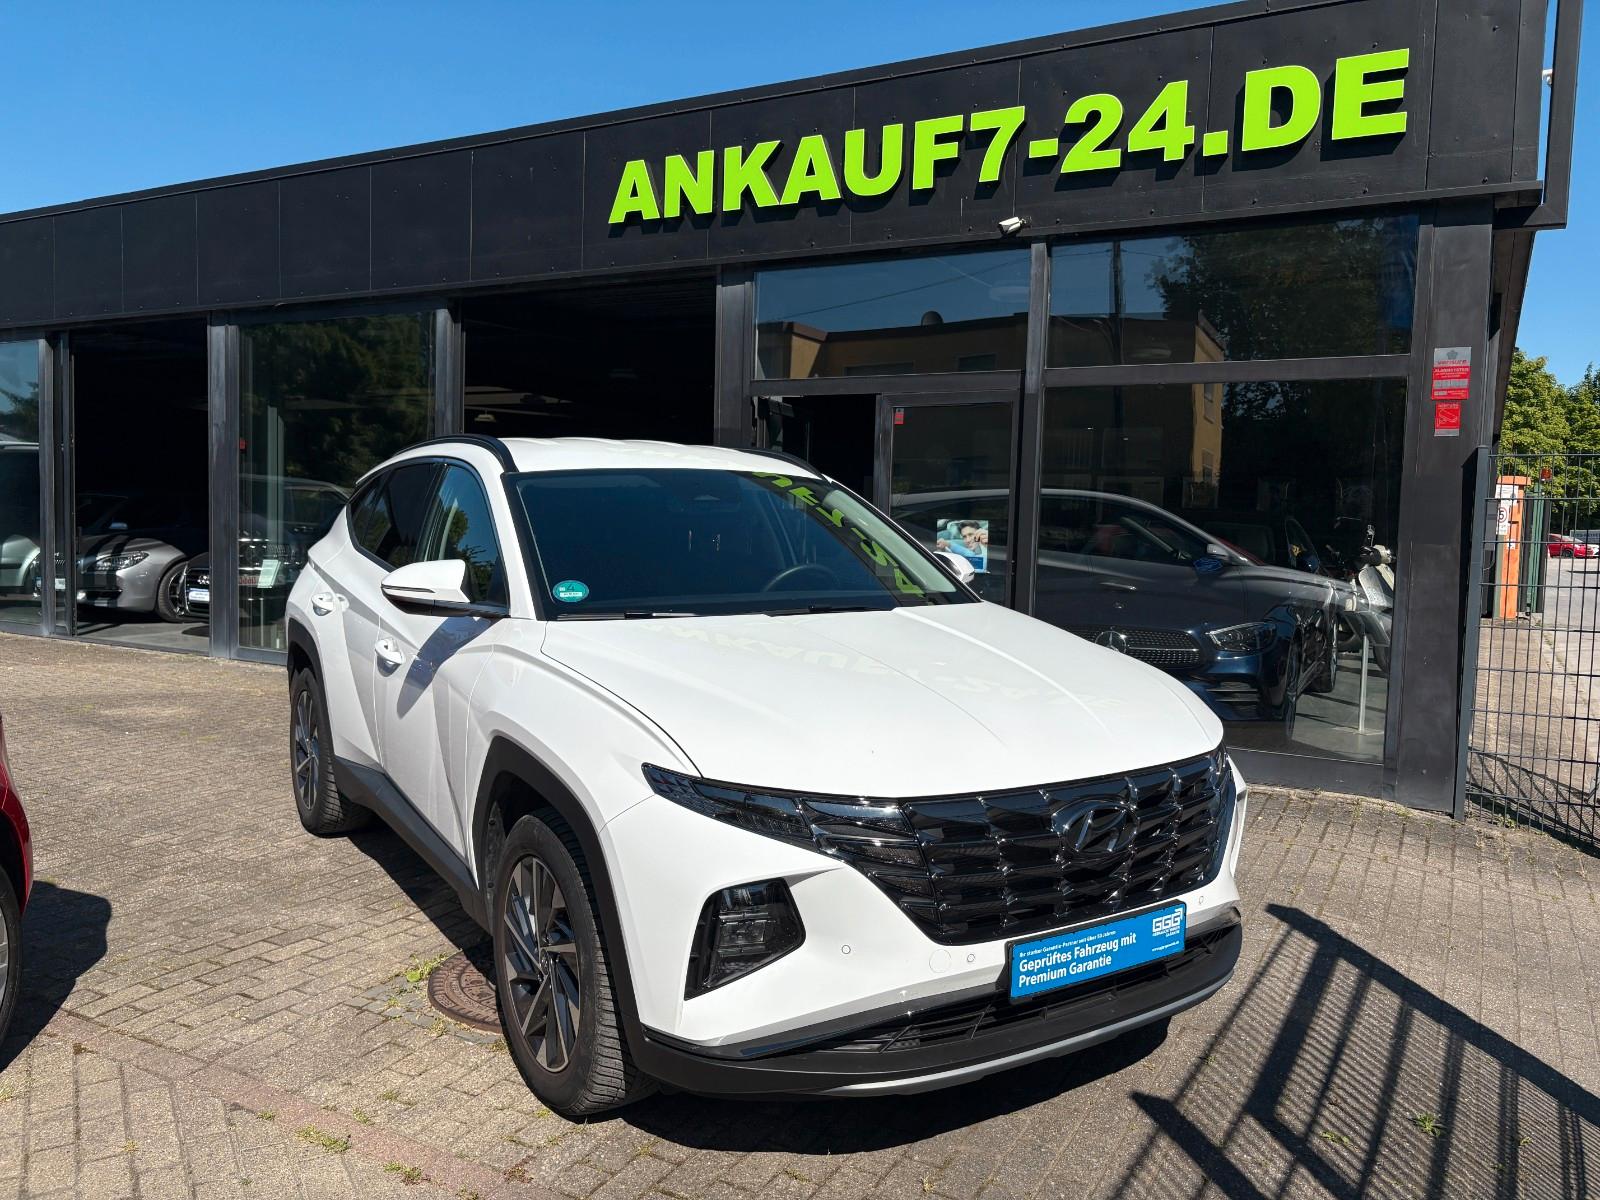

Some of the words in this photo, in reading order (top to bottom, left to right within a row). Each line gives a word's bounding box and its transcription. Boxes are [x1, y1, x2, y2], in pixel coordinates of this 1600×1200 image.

[608, 47, 1410, 225] ANKAUF7-24.DE
[1018, 968, 1067, 988] Premium
[1069, 953, 1112, 975] Garantie
[1019, 951, 1072, 973] Geprüftes
[1074, 938, 1119, 960] Fahrzeug
[1120, 932, 1137, 947] mit
